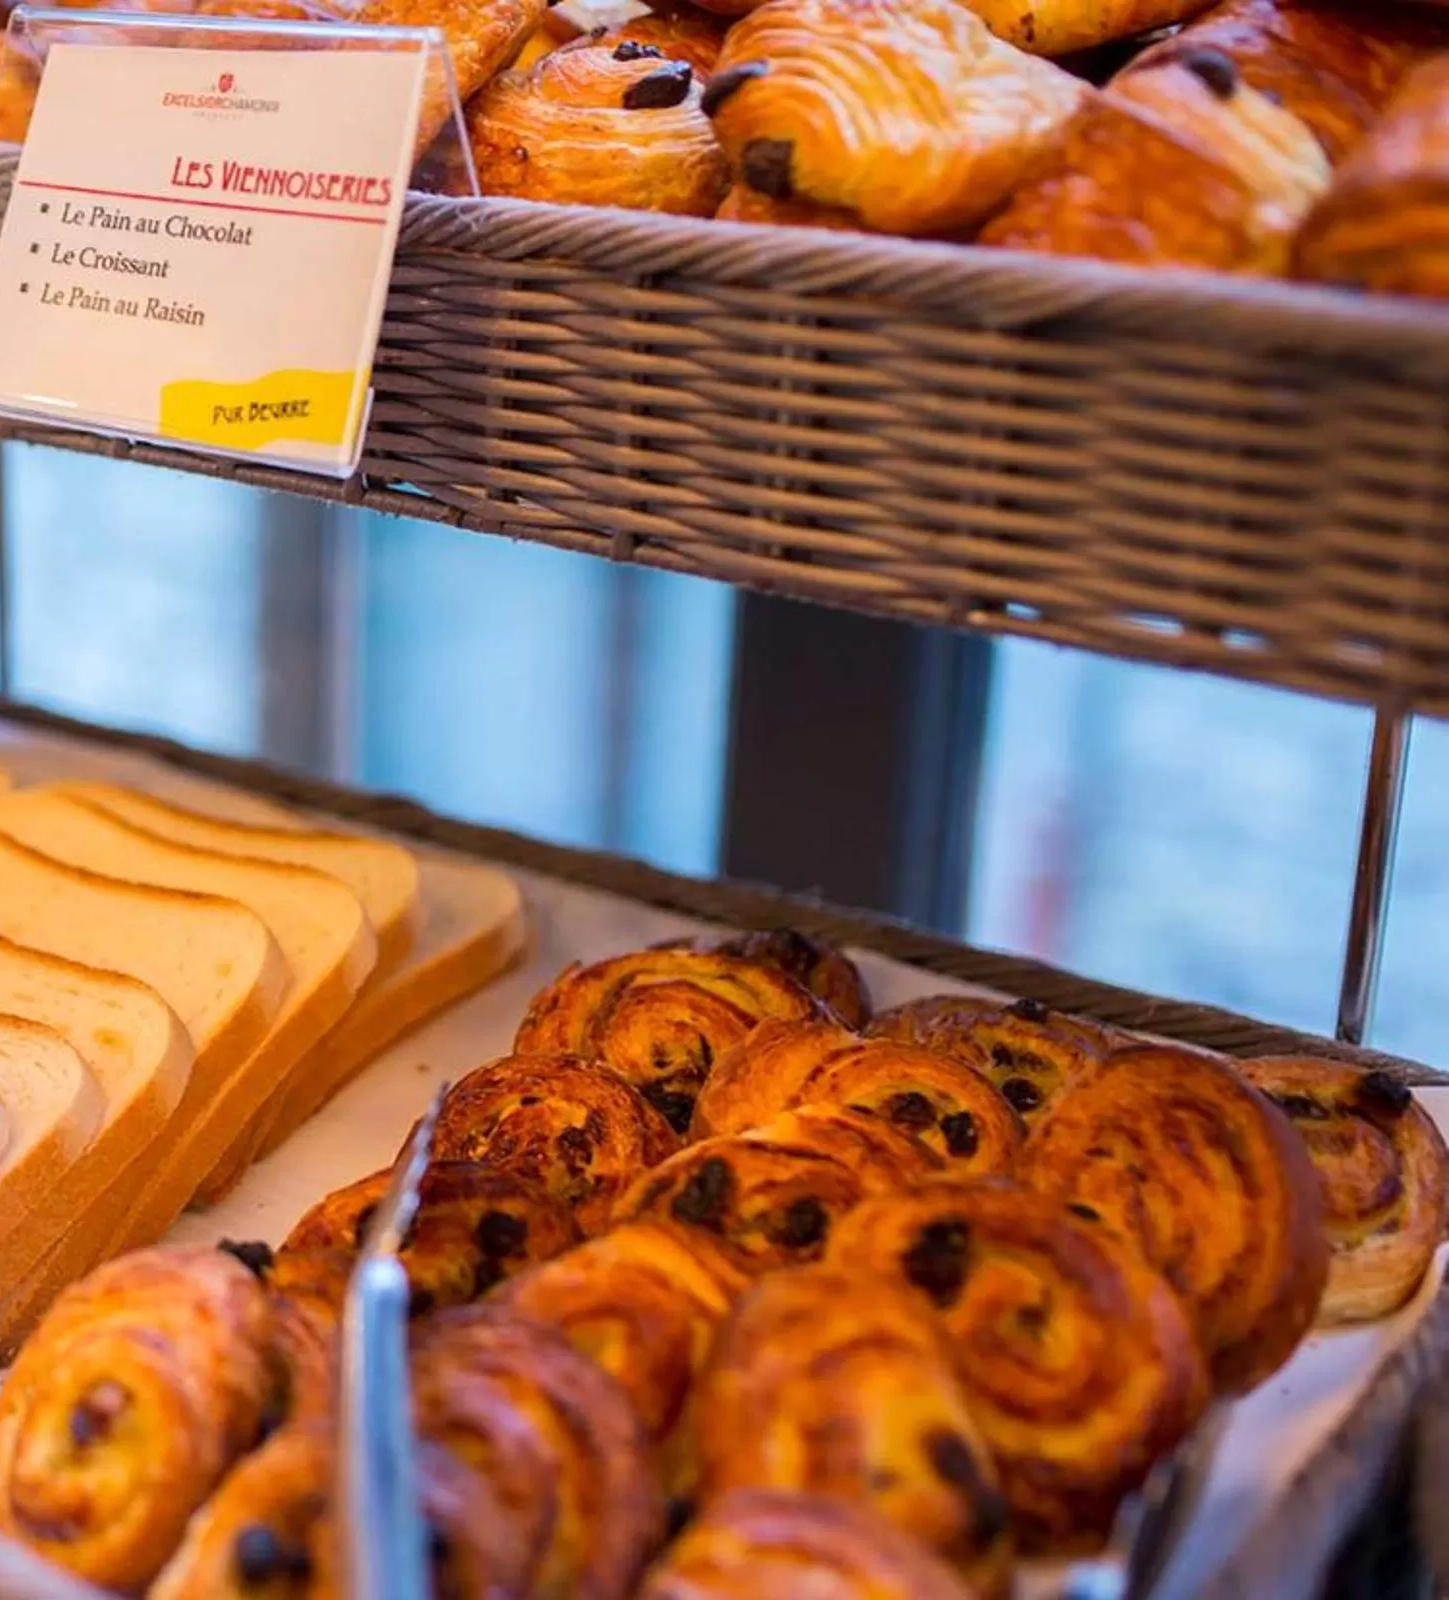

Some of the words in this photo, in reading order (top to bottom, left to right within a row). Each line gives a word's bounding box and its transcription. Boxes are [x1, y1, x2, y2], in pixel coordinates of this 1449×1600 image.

[171, 156, 214, 189] LES
[221, 160, 393, 206] VIENNOISERIES
[61, 202, 85, 225] Le
[88, 205, 131, 232] Pain
[134, 217, 161, 235] au
[165, 214, 253, 246] Chocolat
[51, 242, 75, 265] Le
[79, 246, 170, 278] Croissant
[40, 282, 65, 306] Le
[68, 286, 110, 313] Pain
[114, 299, 139, 317] au
[144, 297, 206, 327] Raisin
[212, 404, 244, 426] PUR
